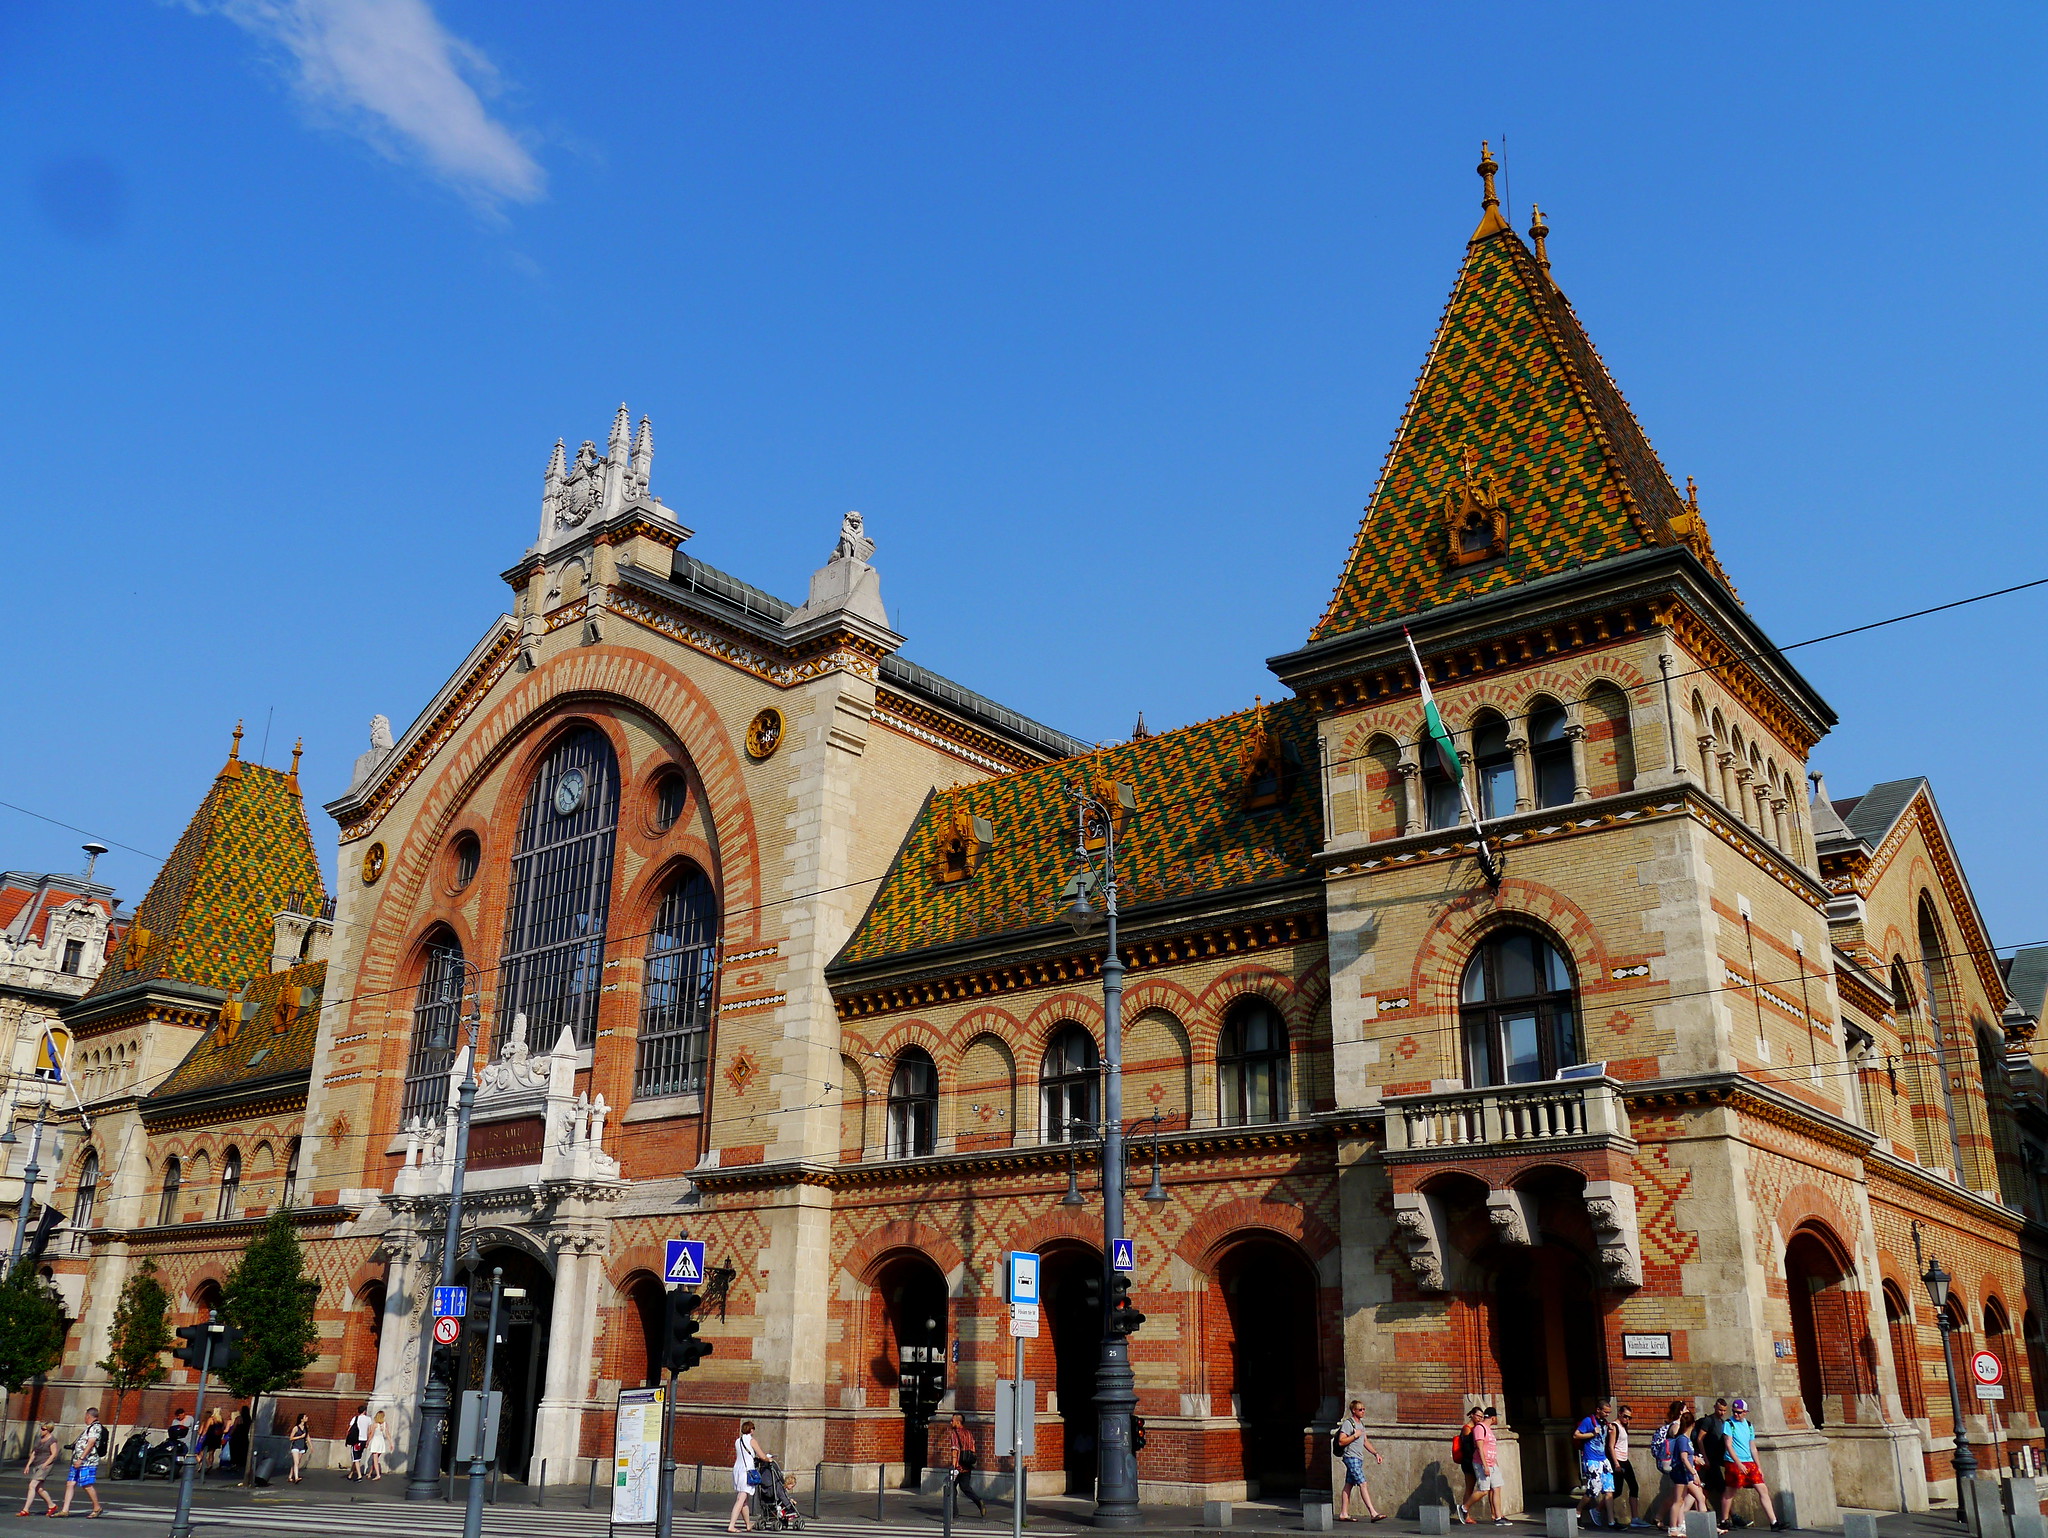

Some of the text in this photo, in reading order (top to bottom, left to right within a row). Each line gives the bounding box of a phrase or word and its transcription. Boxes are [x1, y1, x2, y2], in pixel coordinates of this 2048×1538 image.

[1627, 1340, 1667, 1350] Vámház körút
[1977, 1361, 1985, 1374] 5
